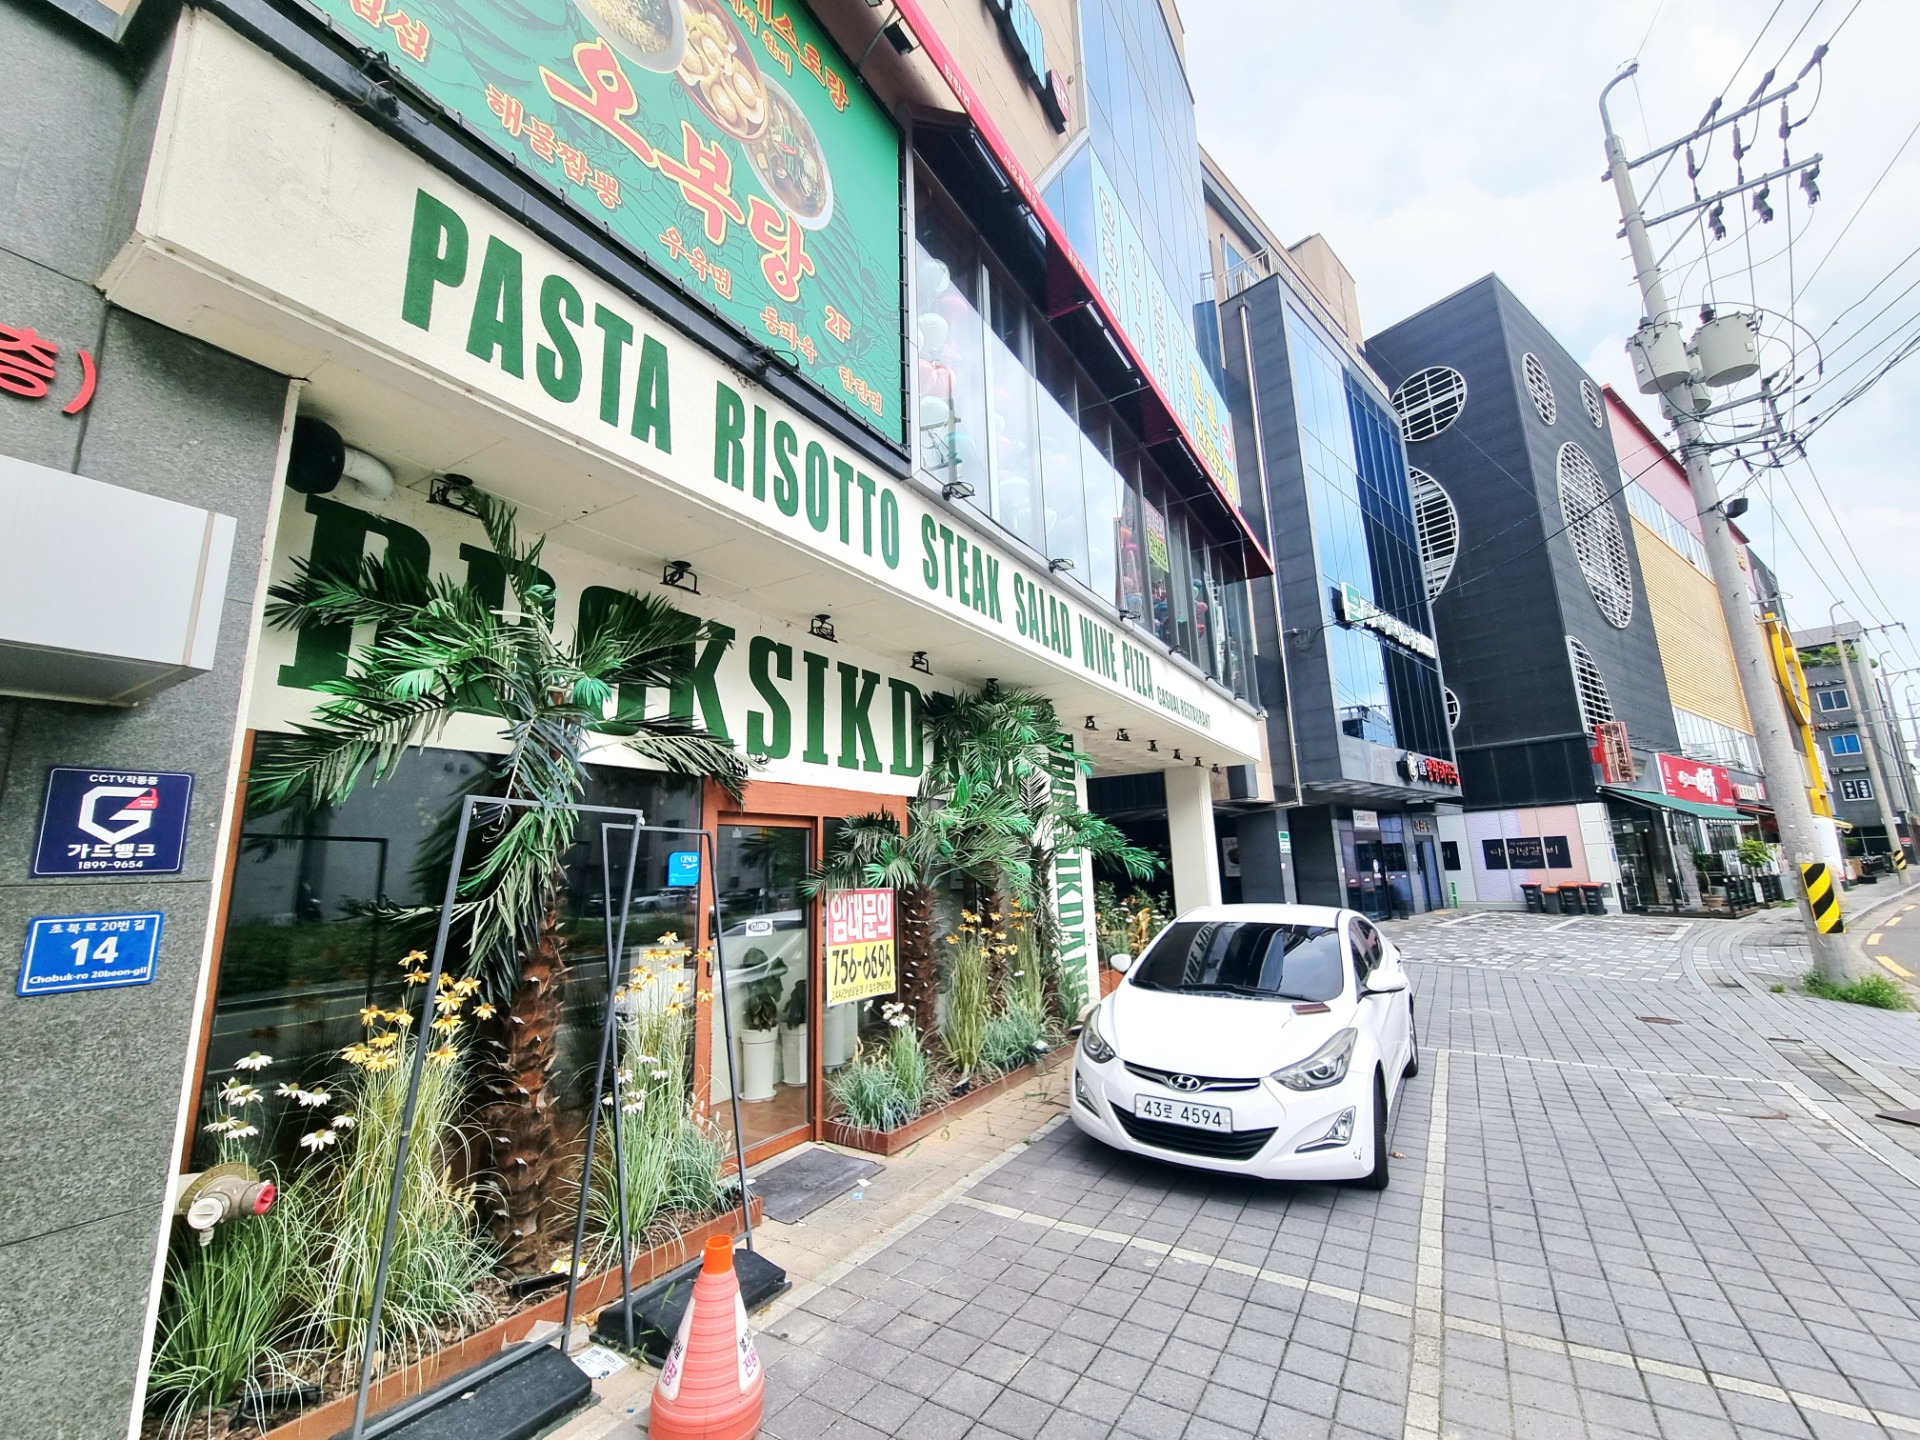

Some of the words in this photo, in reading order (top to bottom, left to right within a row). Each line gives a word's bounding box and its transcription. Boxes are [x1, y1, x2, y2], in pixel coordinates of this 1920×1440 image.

[484, 83, 622, 210] 해물짬뽕
[539, 36, 815, 302] 오복당
[658, 226, 732, 300] 우육면
[759, 305, 818, 365] 동파육
[824, 304, 852, 344] 2F
[838, 364, 884, 417] 탄탄면
[401, 187, 673, 456] PASTA
[713, 380, 900, 571] RISOTTO
[921, 512, 1003, 624] STEAK
[1013, 571, 1072, 659] SALAD
[1079, 614, 1118, 683] WINE
[1122, 639, 1154, 701] PIZZA
[89, 774, 159, 785] CCTV작동중
[67, 843, 157, 859] 가드뱅크
[78, 860, 144, 870] 1899-9654
[830, 892, 893, 943] 임대문의
[70, 936, 119, 966] 14
[831, 944, 892, 987] 756-6696
[29, 972, 89, 985] Chobuk-ro
[1181, 1106, 1222, 1127] 4594
